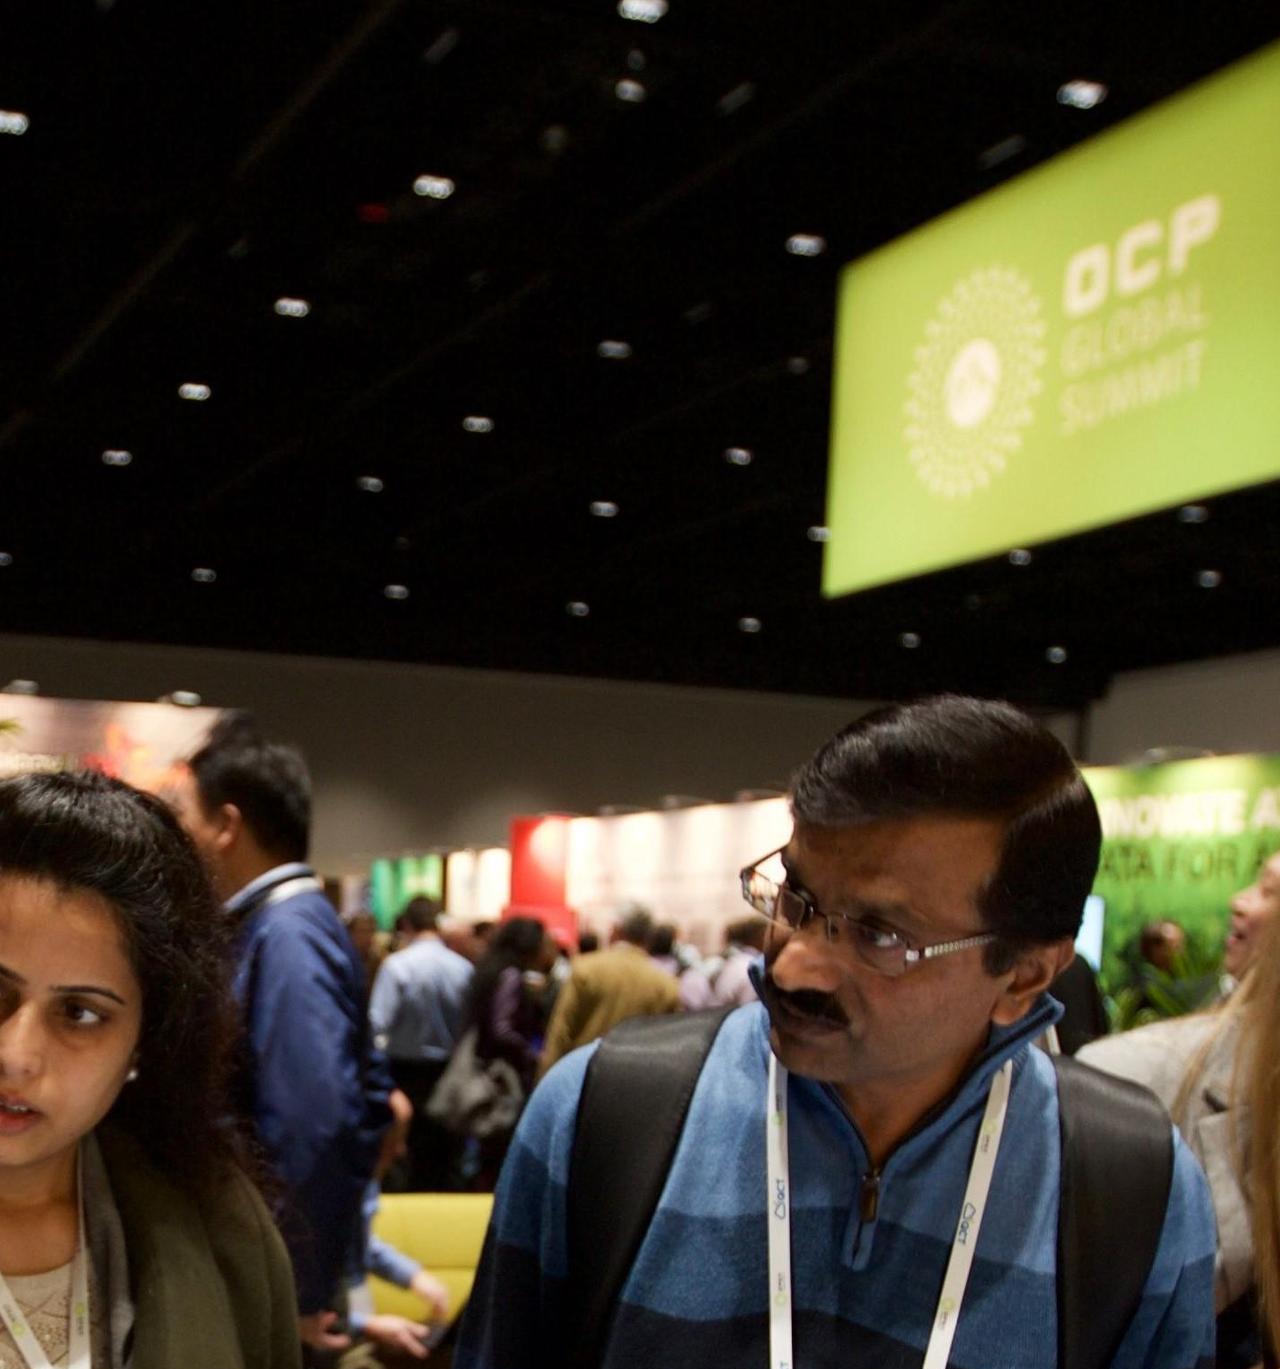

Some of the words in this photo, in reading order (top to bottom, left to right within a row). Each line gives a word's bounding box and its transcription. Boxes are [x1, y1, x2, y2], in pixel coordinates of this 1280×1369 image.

[1063, 193, 1223, 318] OCP
[1060, 285, 1210, 374] GLOBAL
[1059, 340, 1207, 434] SUMMIT
